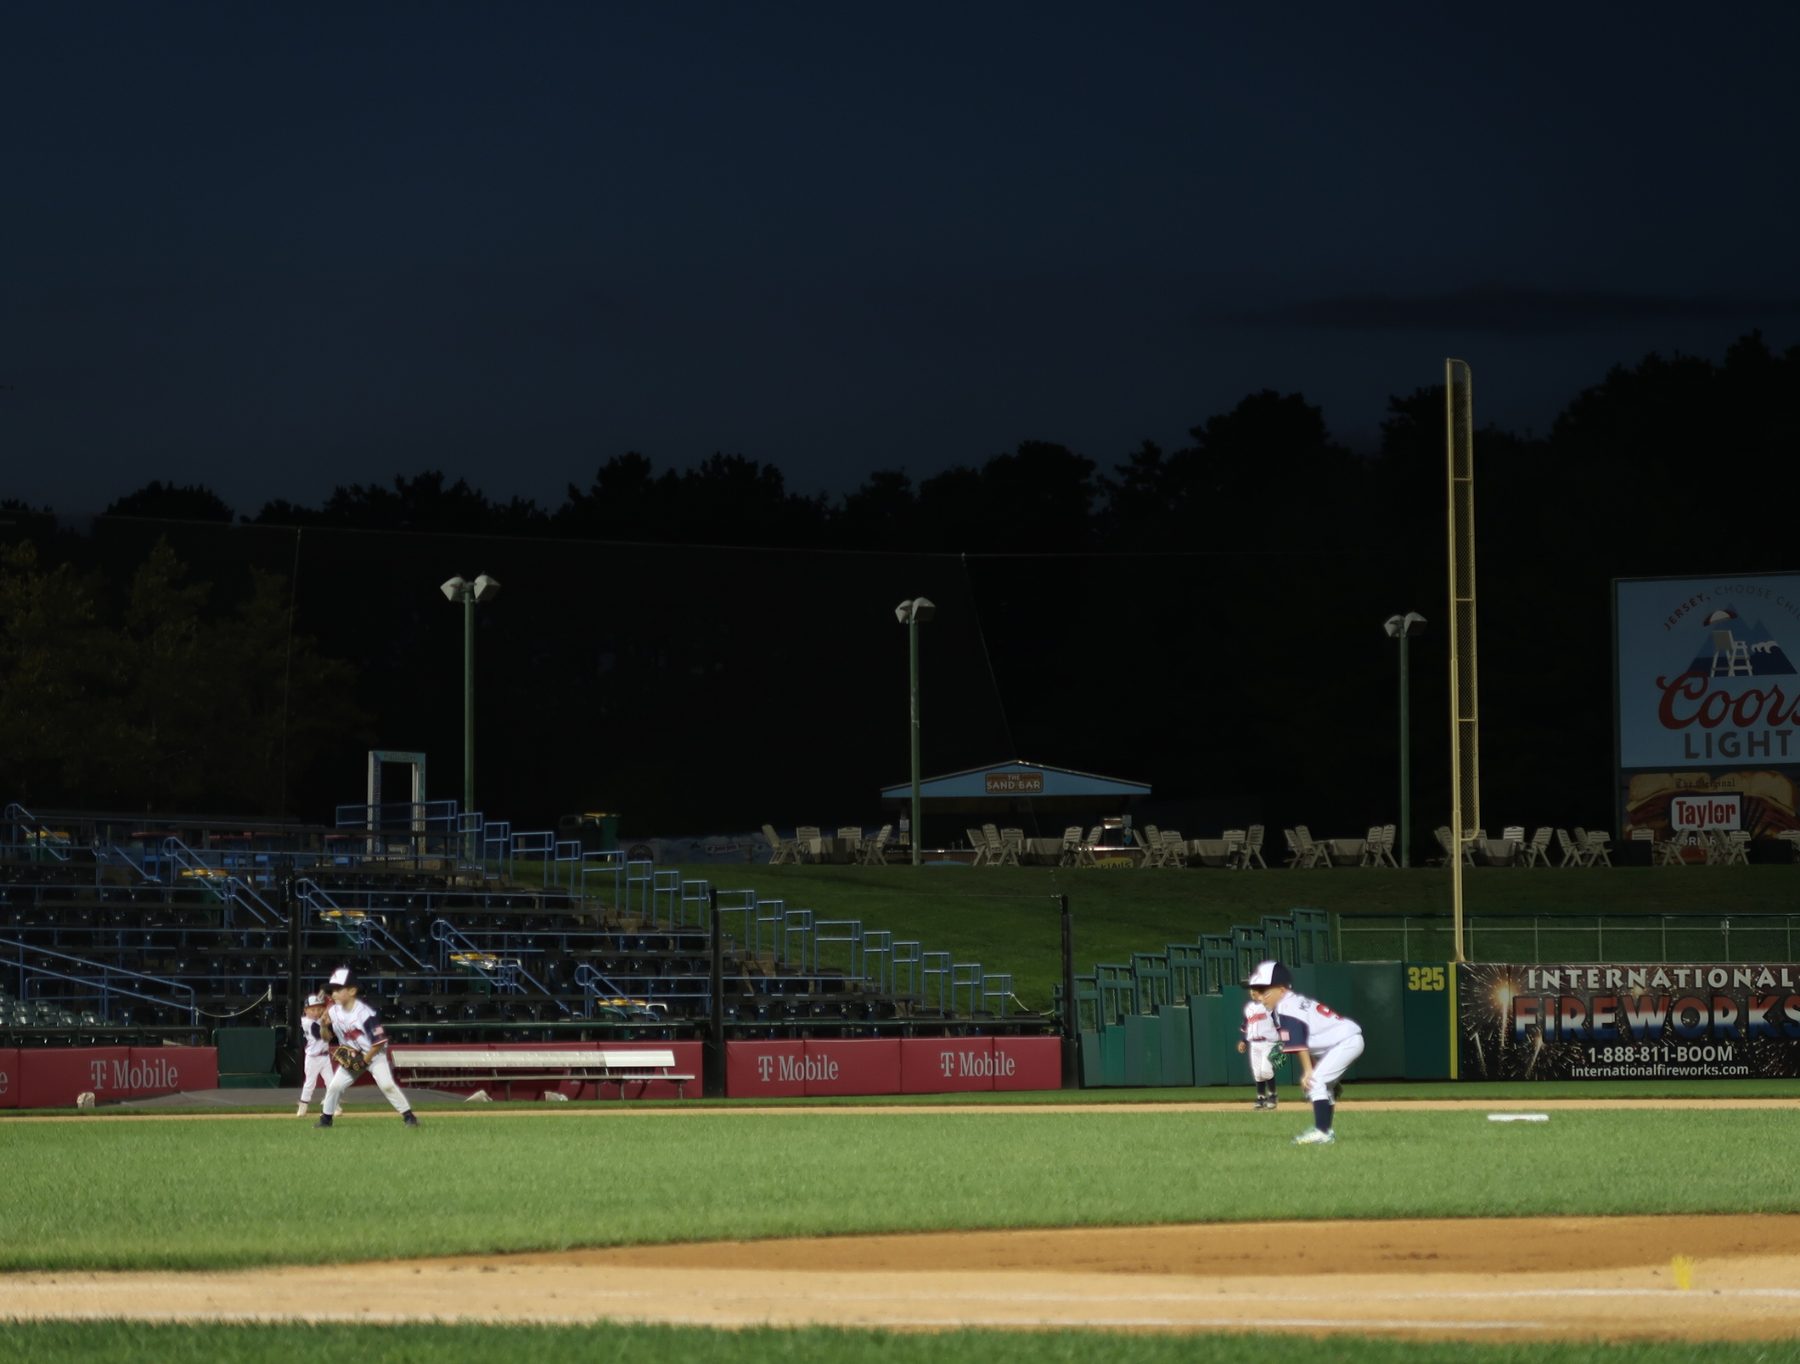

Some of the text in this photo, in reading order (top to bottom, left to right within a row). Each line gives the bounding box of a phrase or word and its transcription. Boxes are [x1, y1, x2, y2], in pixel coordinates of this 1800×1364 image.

[1663, 584, 1800, 631] JERSEY, CHOOSE CHI
[1684, 730, 1793, 760] LIGHT
[986, 779, 1041, 790] SAND BAR
[1675, 799, 1736, 828] Taylor
[1408, 967, 1445, 991] 325
[1528, 967, 1794, 990] INTERNATIONAL
[1513, 995, 1800, 1042] FIREWORKS
[778, 1054, 839, 1081] Mobile
[959, 1051, 1015, 1076] Mobile
[1588, 1046, 1733, 1063] 1-888-811-BOOM
[112, 1059, 178, 1089] Mobile
[1571, 1063, 1749, 1078] internationalfireworks.com
